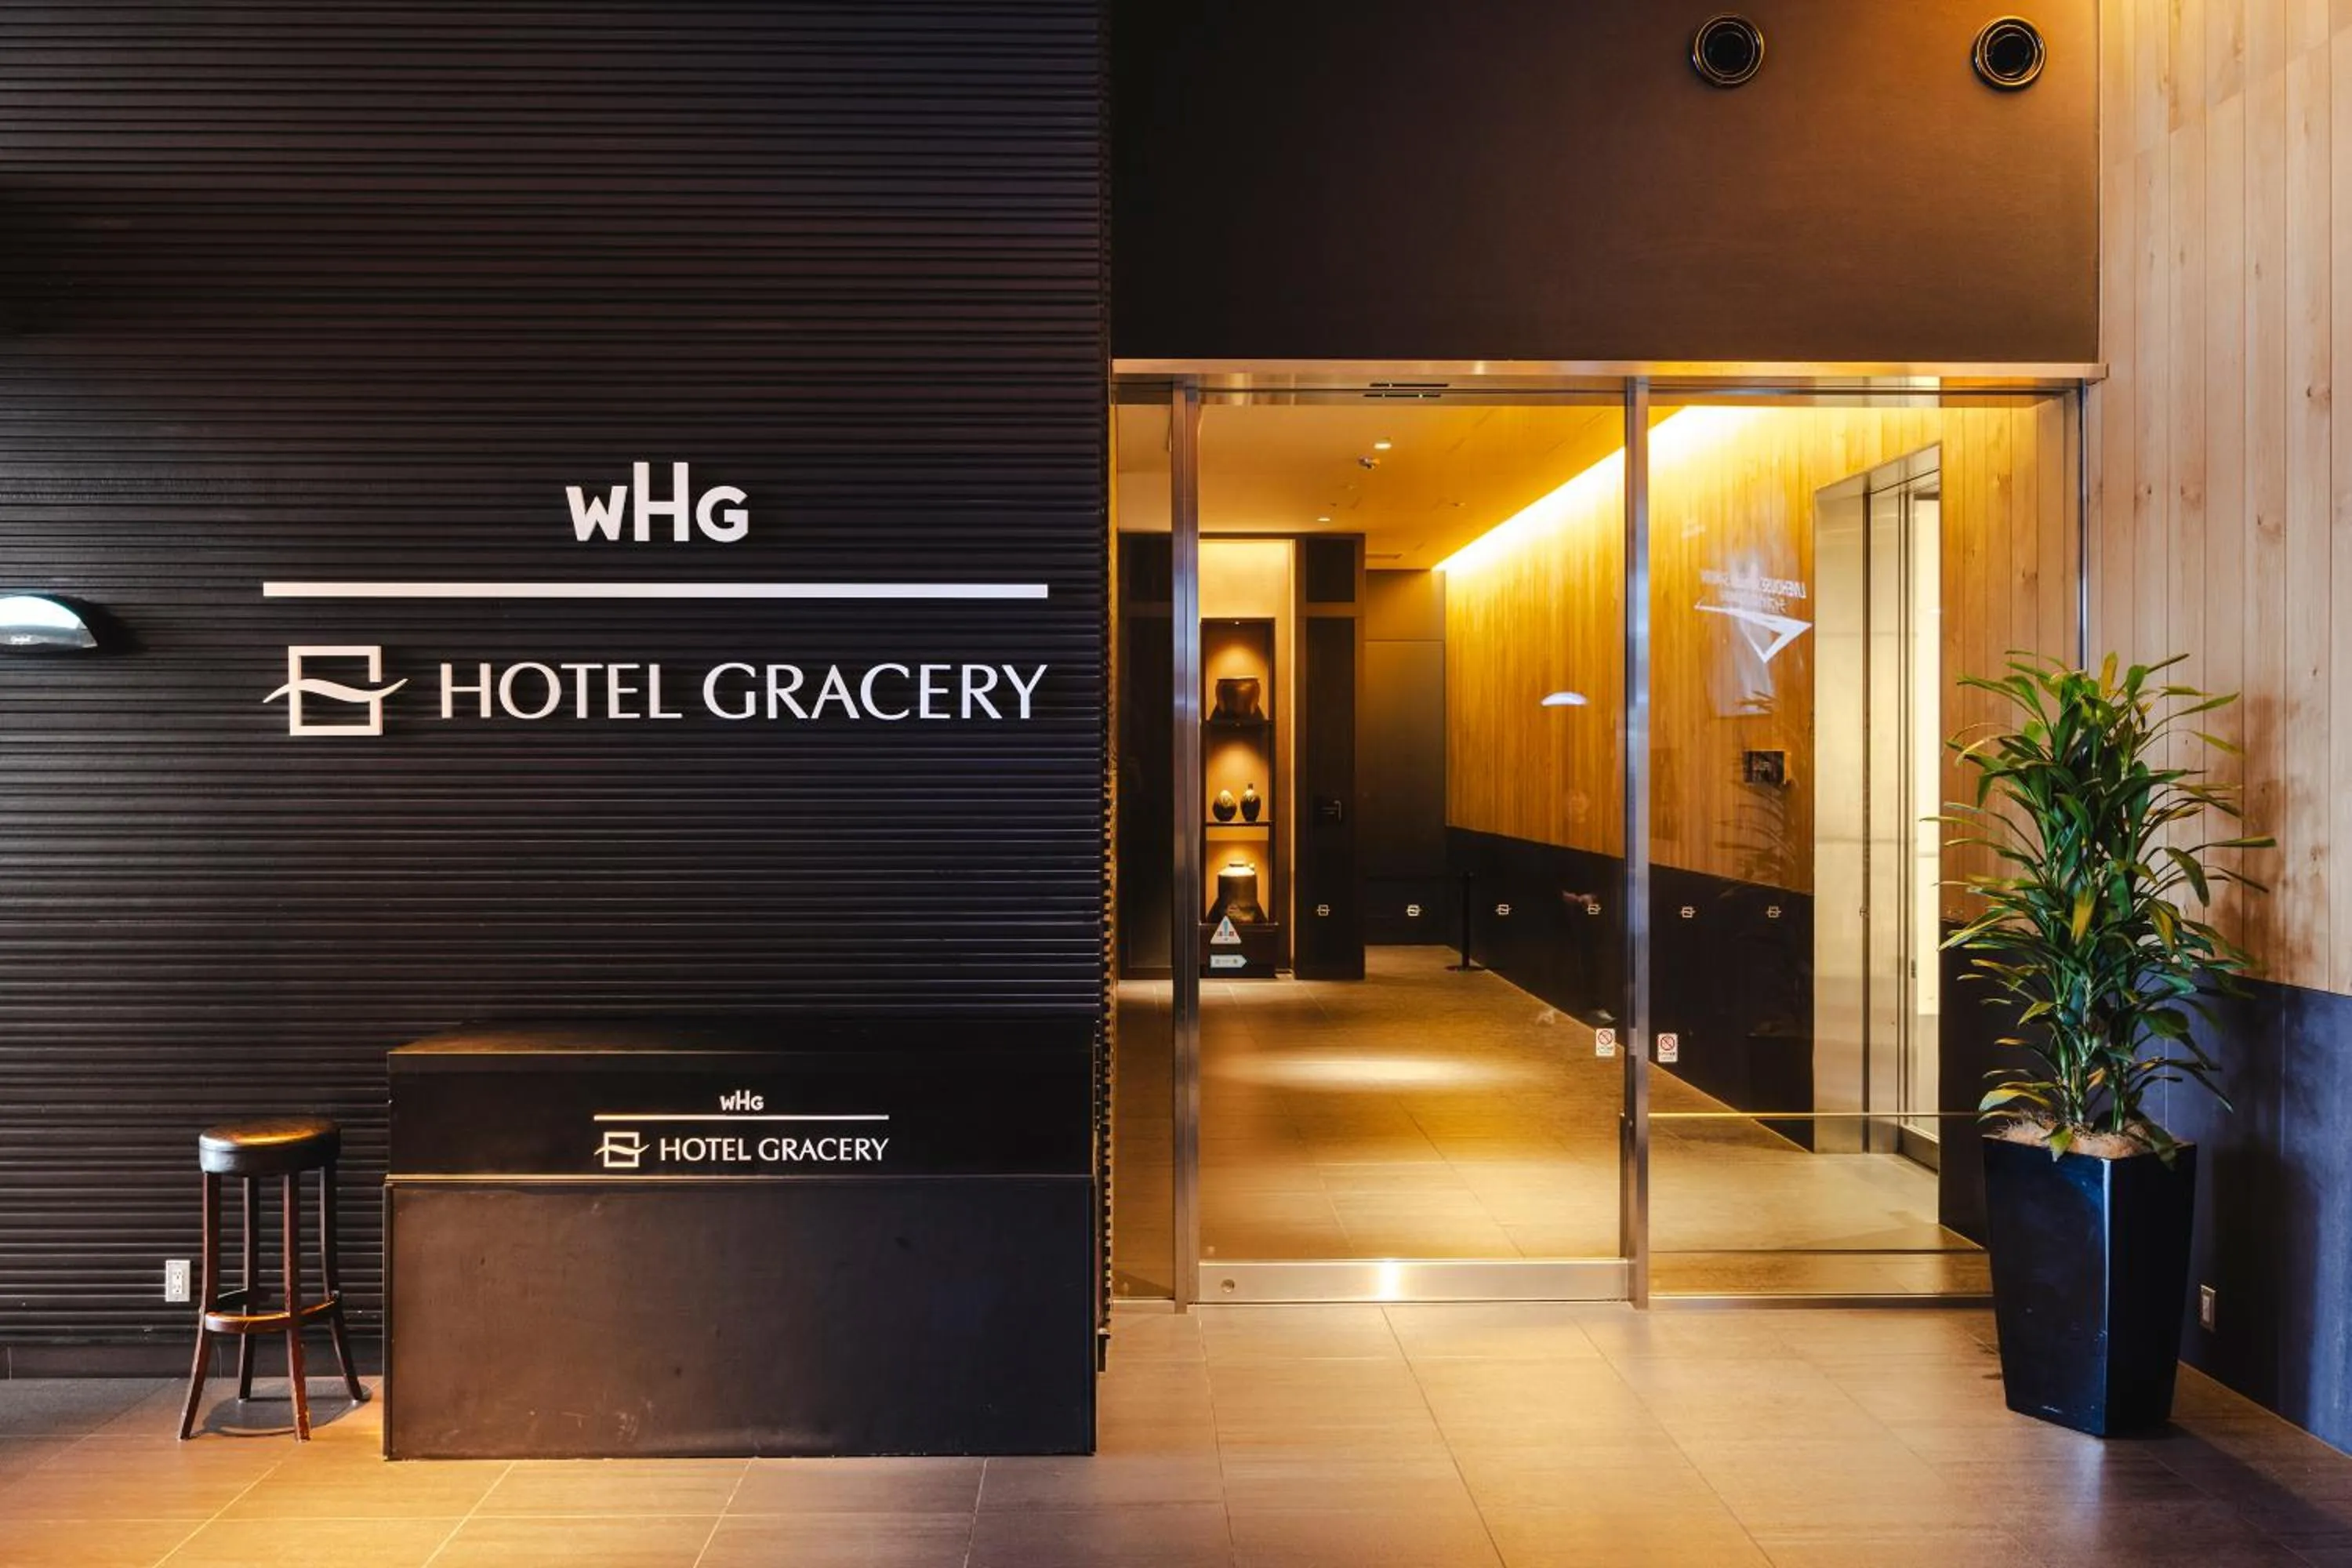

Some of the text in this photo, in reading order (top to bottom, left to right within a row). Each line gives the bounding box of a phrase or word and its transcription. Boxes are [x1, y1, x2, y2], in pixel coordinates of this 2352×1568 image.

[565, 461, 749, 543] WHG
[440, 662, 1048, 720] HOTEL GRACERY
[659, 1138, 889, 1161] HOTEL GRACERY
